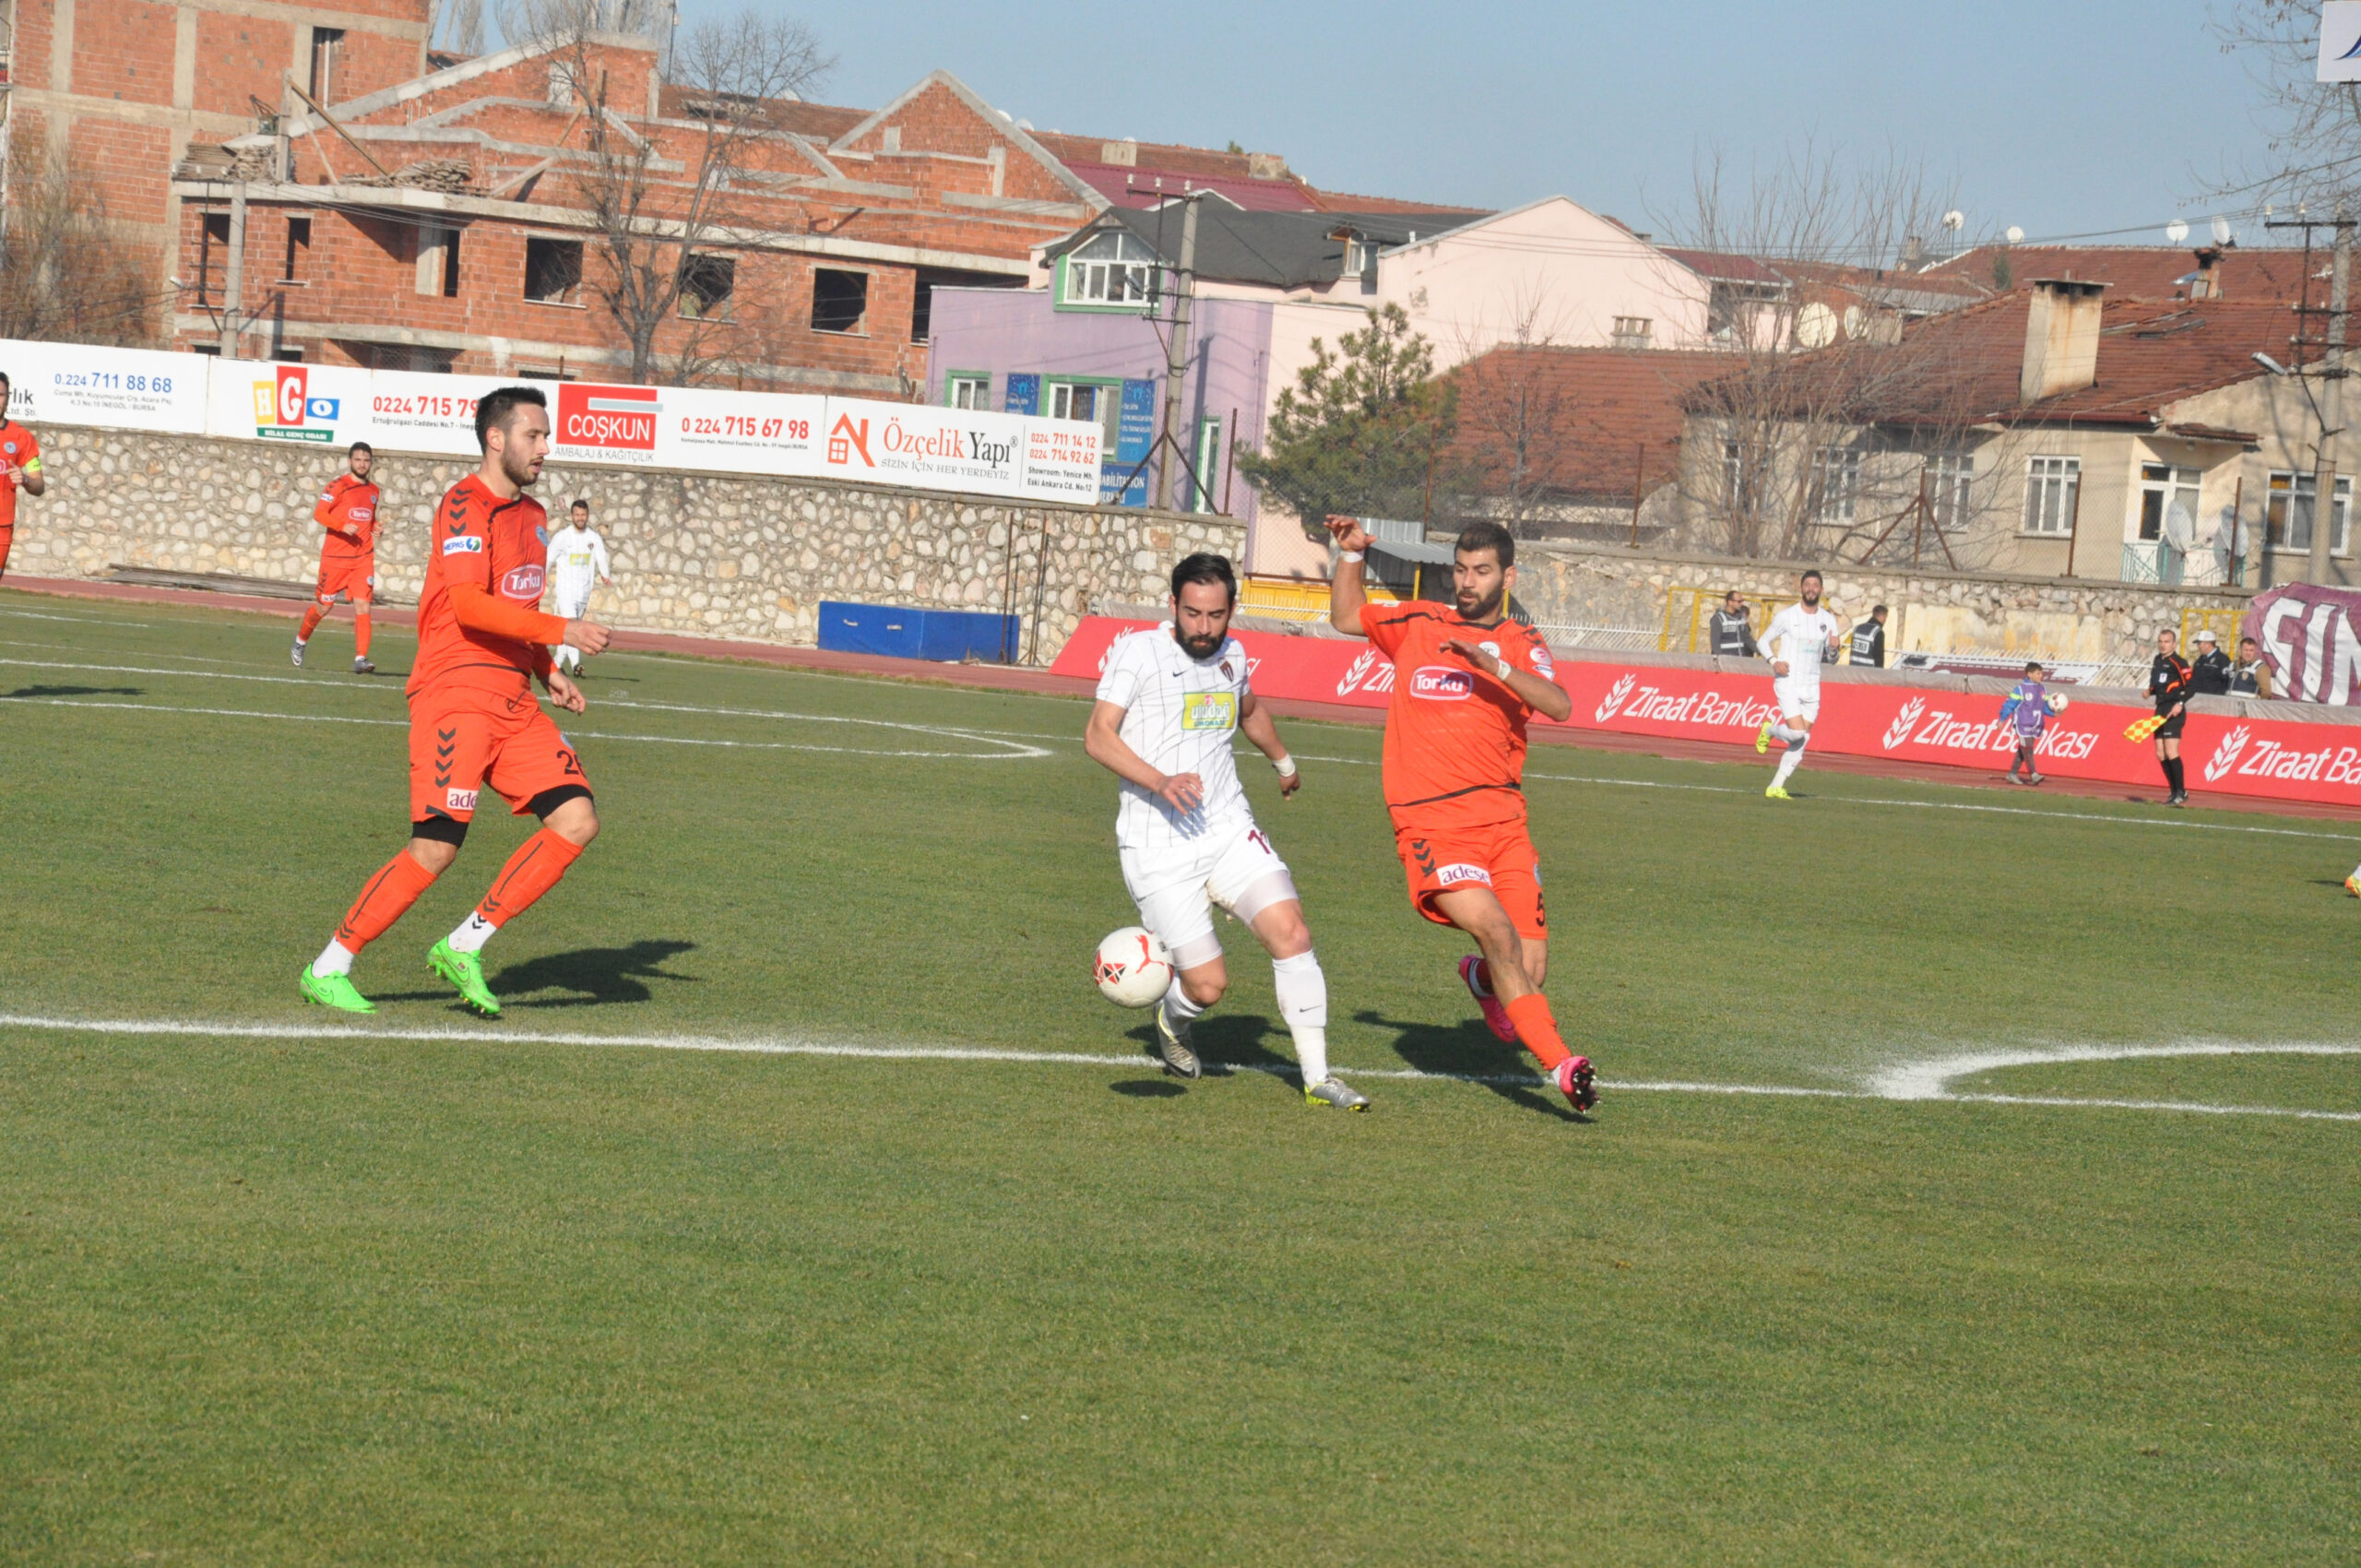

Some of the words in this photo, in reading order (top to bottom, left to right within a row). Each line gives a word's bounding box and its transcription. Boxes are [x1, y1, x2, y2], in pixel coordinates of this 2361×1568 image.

[55, 374, 87, 386] 0.224
[92, 373, 119, 388] 711
[126, 374, 146, 391] 88
[152, 376, 172, 393] 68
[9, 387, 33, 405] lık
[373, 396, 412, 414] 0224
[417, 396, 451, 416] 715
[568, 414, 649, 443] COŞKUN
[682, 418, 690, 432] 0
[694, 418, 720, 434] 224
[726, 416, 755, 436] 715
[762, 418, 783, 437] 67
[789, 420, 809, 439] 98
[883, 417, 965, 460] Özçelik
[1031, 433, 1049, 444] 0224
[1053, 433, 1068, 445] 711
[1073, 435, 1083, 446] 14
[1086, 436, 1097, 448] 12
[555, 446, 595, 459] AMBALAJ
[598, 448, 603, 458] &
[1029, 448, 1048, 459] 0224
[1051, 448, 1068, 461] 714
[1071, 451, 1081, 463] 92
[1084, 452, 1095, 464] 62
[881, 457, 908, 470] SİZİN
[911, 460, 934, 474] İÇİN
[936, 466, 957, 476] HER
[959, 466, 1010, 481] YERDEYİZ
[1063, 469, 1082, 479] Yenice
[1084, 470, 1094, 480] Mh.
[1027, 478, 1040, 487] Eski
[1041, 480, 1062, 489] Ankara
[1064, 481, 1074, 490] Cd.
[511, 573, 540, 590] Torku
[1417, 674, 1464, 693] Torku
[1623, 686, 1699, 721] Ziraat
[2032, 709, 2042, 729] 7
[1913, 711, 1999, 750] Ziraat
[2237, 741, 2331, 781] Ziraat
[1442, 865, 1489, 884] adese
[1536, 892, 1546, 927] 5
